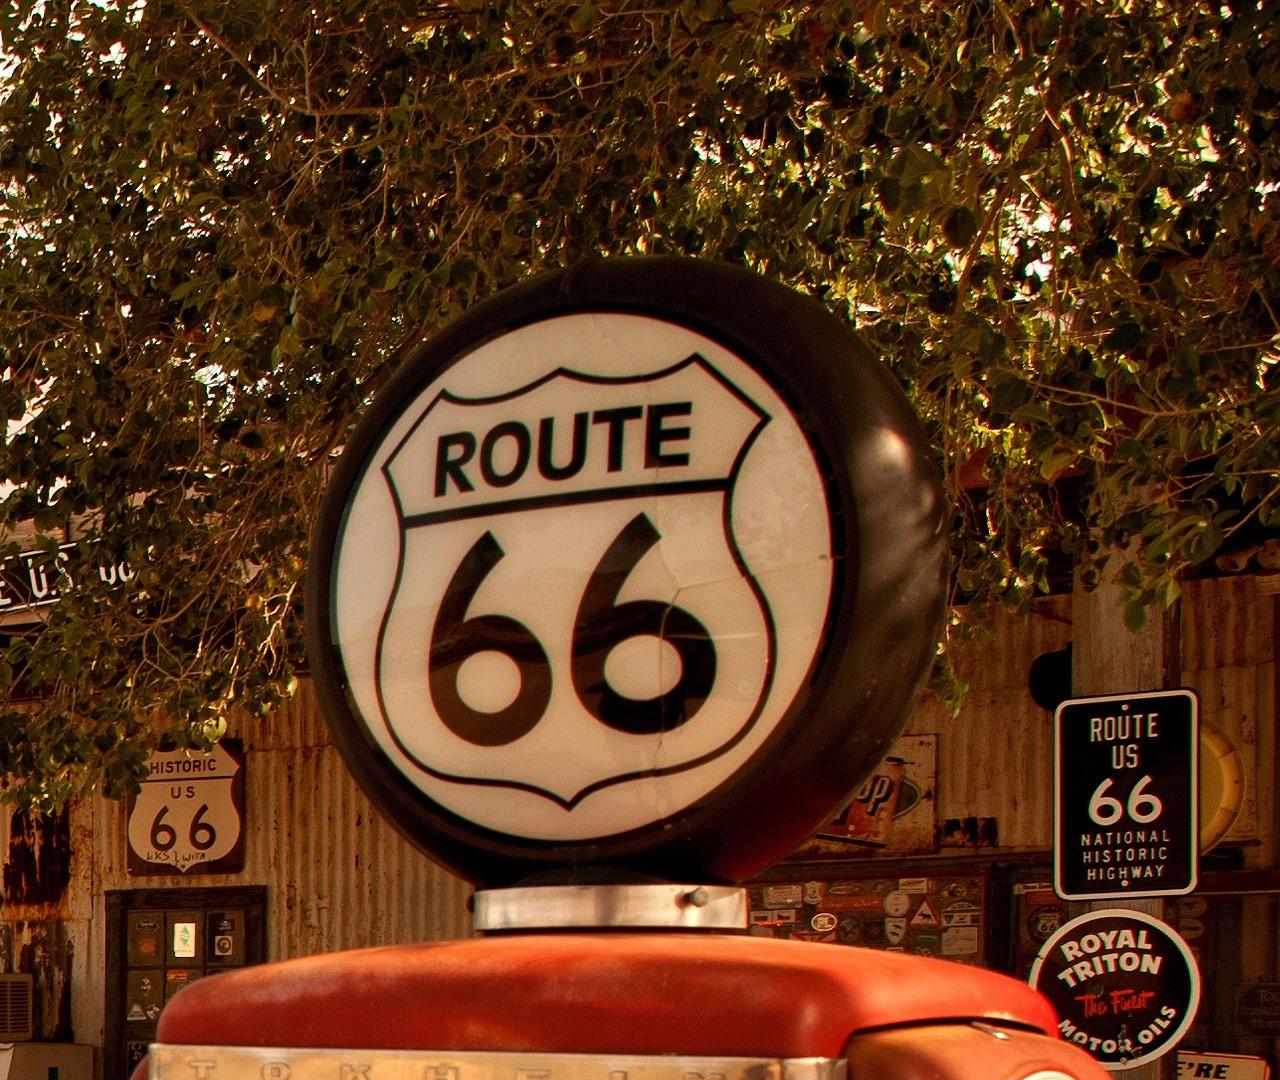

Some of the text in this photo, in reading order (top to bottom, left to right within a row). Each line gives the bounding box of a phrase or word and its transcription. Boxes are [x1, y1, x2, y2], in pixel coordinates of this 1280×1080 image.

[434, 401, 692, 498] ROUTE
[429, 512, 717, 747] 66
[1090, 713, 1159, 742] ROUTE
[150, 759, 216, 774] HISTORIC
[1112, 744, 1138, 769] US
[171, 786, 195, 798] US
[1089, 775, 1162, 826] 66
[151, 804, 216, 851] 66
[1081, 830, 1170, 846] NATIONAL
[1083, 847, 1167, 863] HISTORIC
[1087, 865, 1164, 880] HIGHWAY
[1060, 930, 1152, 962] ROYAL
[1057, 952, 1162, 988] TRITON
[1075, 989, 1155, 1017] The Finest
[1058, 1006, 1176, 1053] MOTOR OILS
